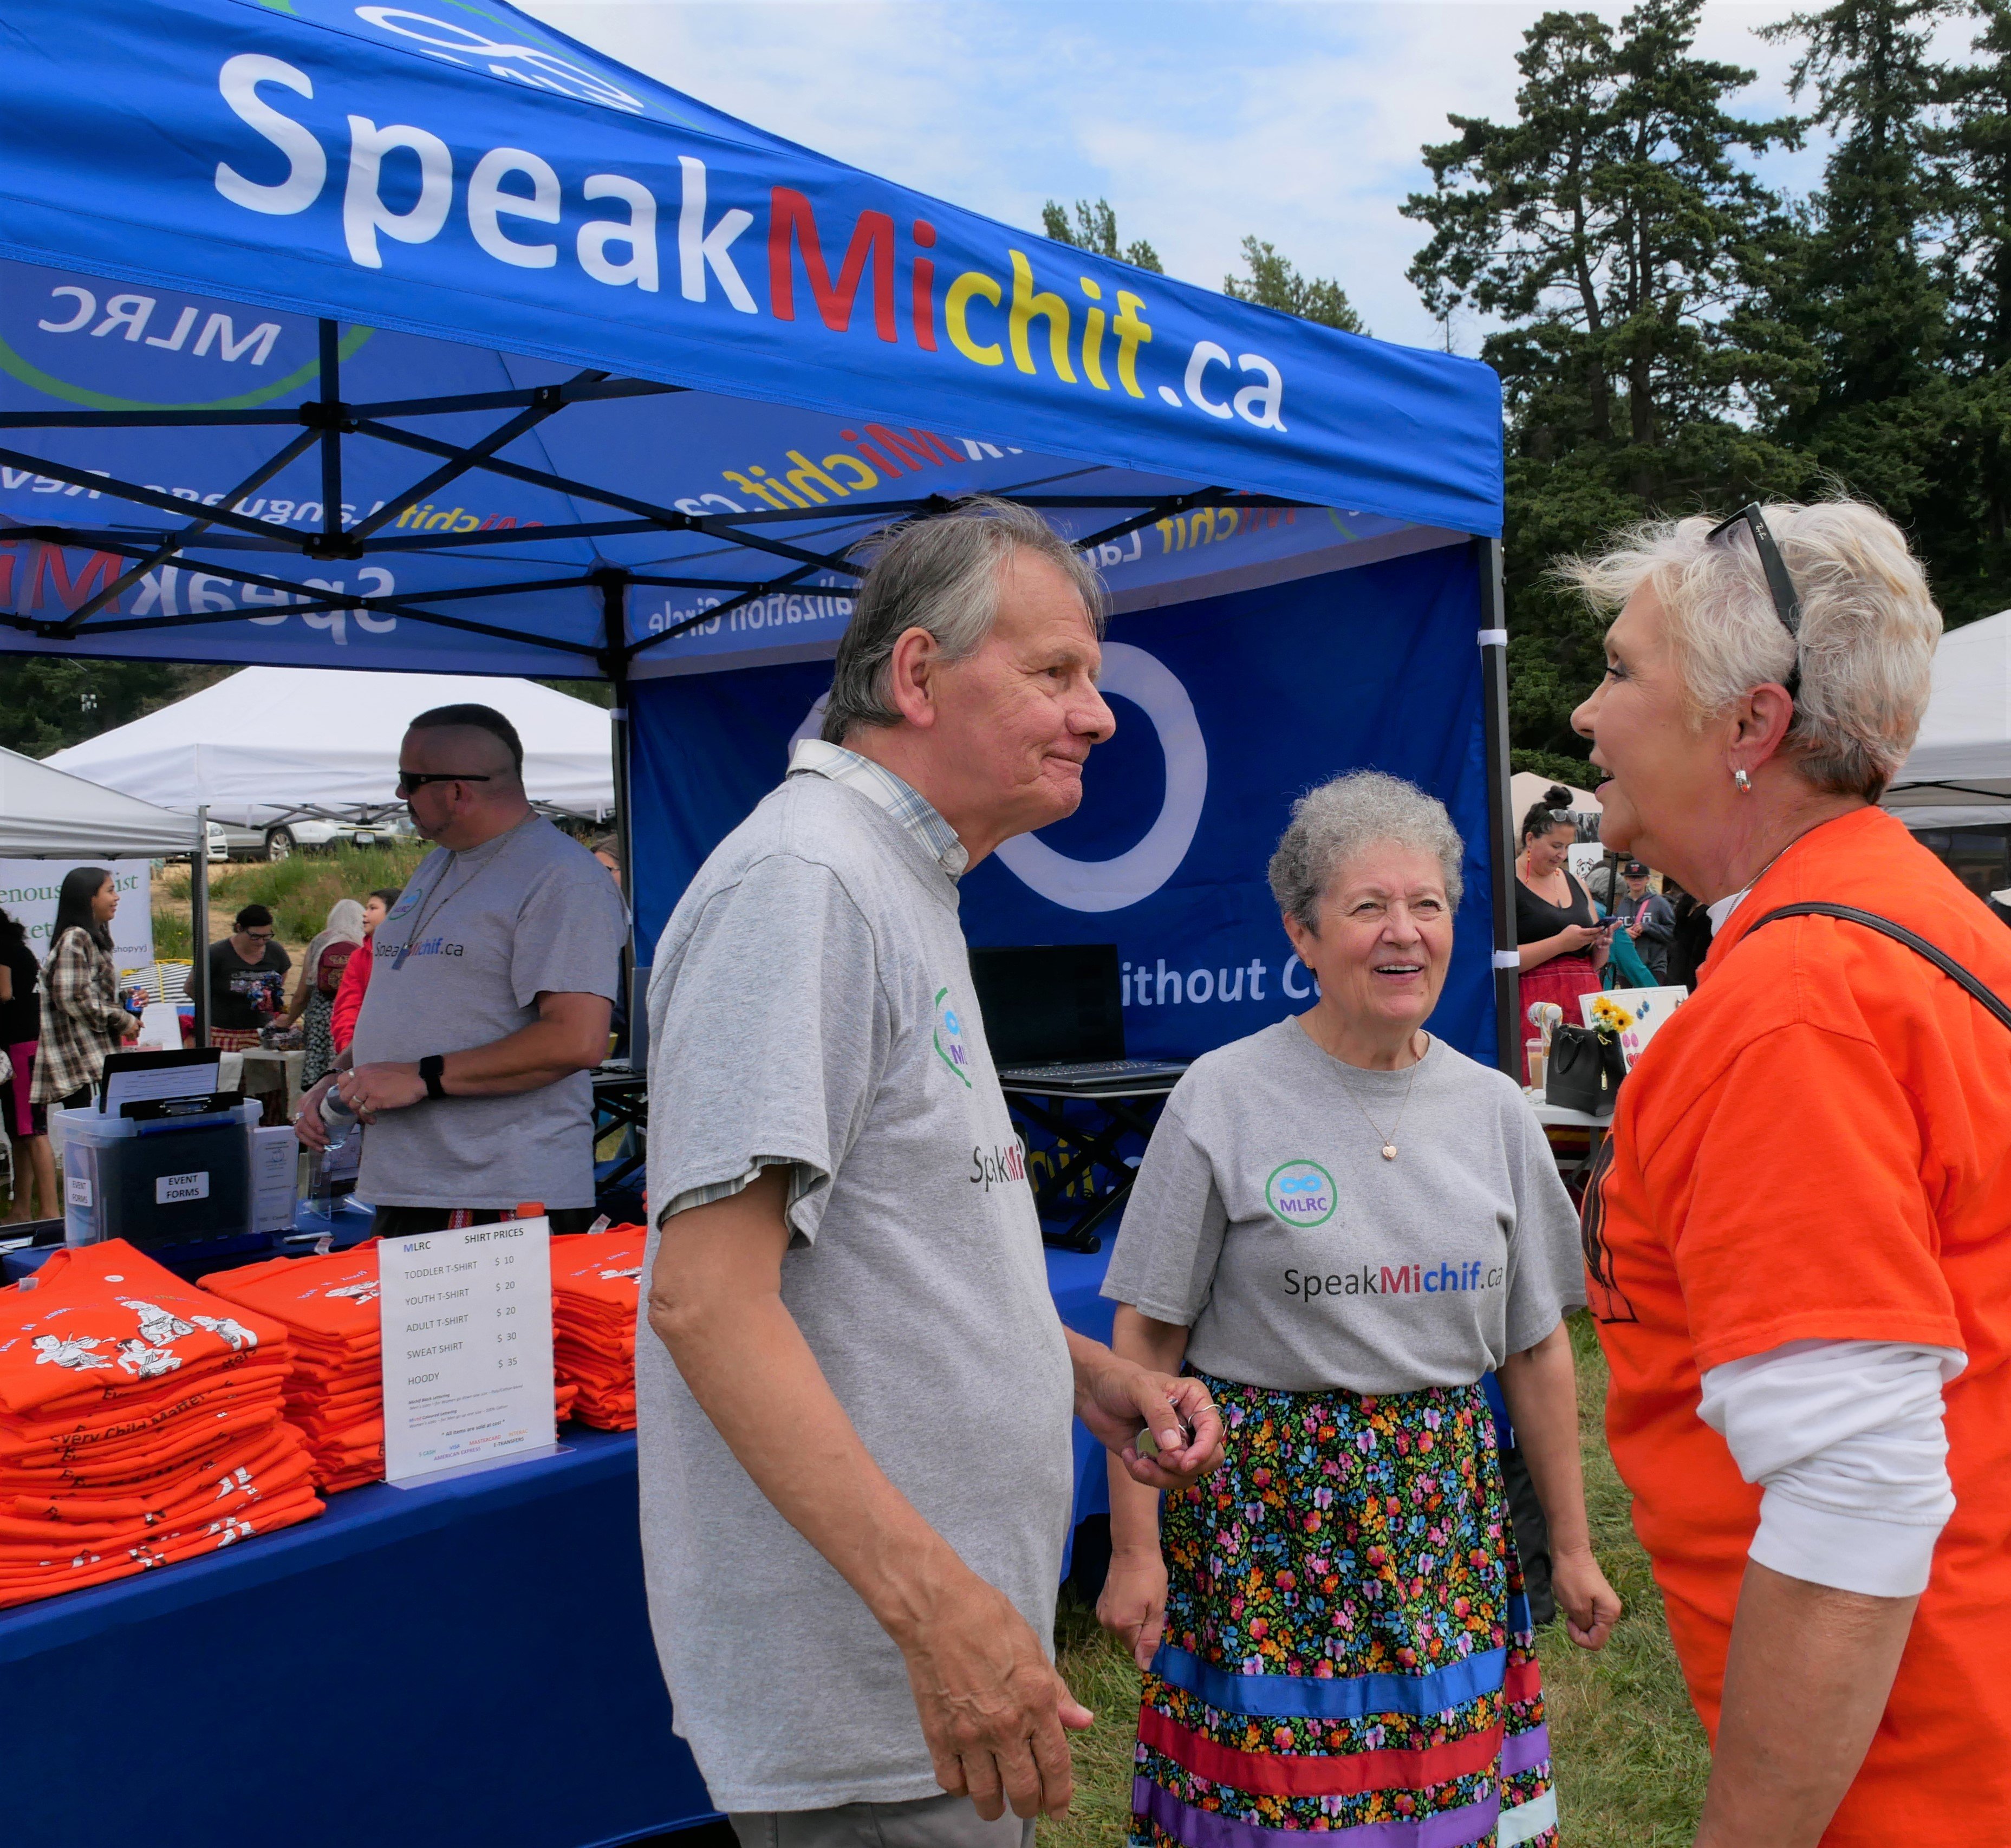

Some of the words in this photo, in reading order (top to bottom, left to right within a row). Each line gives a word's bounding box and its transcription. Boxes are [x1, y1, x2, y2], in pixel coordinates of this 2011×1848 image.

[215, 53, 1287, 433] SpeakMichif.ca
[1122, 958, 1267, 1006] ithout
[168, 1175, 198, 1186] EVENT
[167, 1188, 199, 1199] FORMS
[1279, 1197, 1327, 1212] MLRC
[404, 1241, 431, 1252] MLRC
[465, 1232, 491, 1244] SHIRT
[494, 1228, 524, 1239] PRICES
[405, 1266, 444, 1279] TODDLER
[446, 1261, 477, 1273] T-SHIRT
[505, 1255, 514, 1264] 10
[405, 1295, 435, 1306] YOUTH
[438, 1289, 469, 1300] T-SHIRT
[505, 1281, 515, 1290] 20
[1284, 1261, 1503, 1302] SpeakMichif.ca
[406, 1320, 434, 1332] ADULT
[437, 1315, 468, 1326] T-SHIRT
[506, 1306, 516, 1315] 20
[407, 1346, 437, 1359] SWEAT
[439, 1342, 463, 1353] SHIRT
[507, 1332, 517, 1341] 30
[408, 1372, 440, 1385] HOODY
[507, 1357, 517, 1366] 35
[433, 1450, 460, 1461] AMERICAN
[460, 1446, 481, 1455] EXPRESS
[493, 1436, 525, 1448] E-TRANSFERS
[469, 1434, 502, 1446] MASTERCARD
